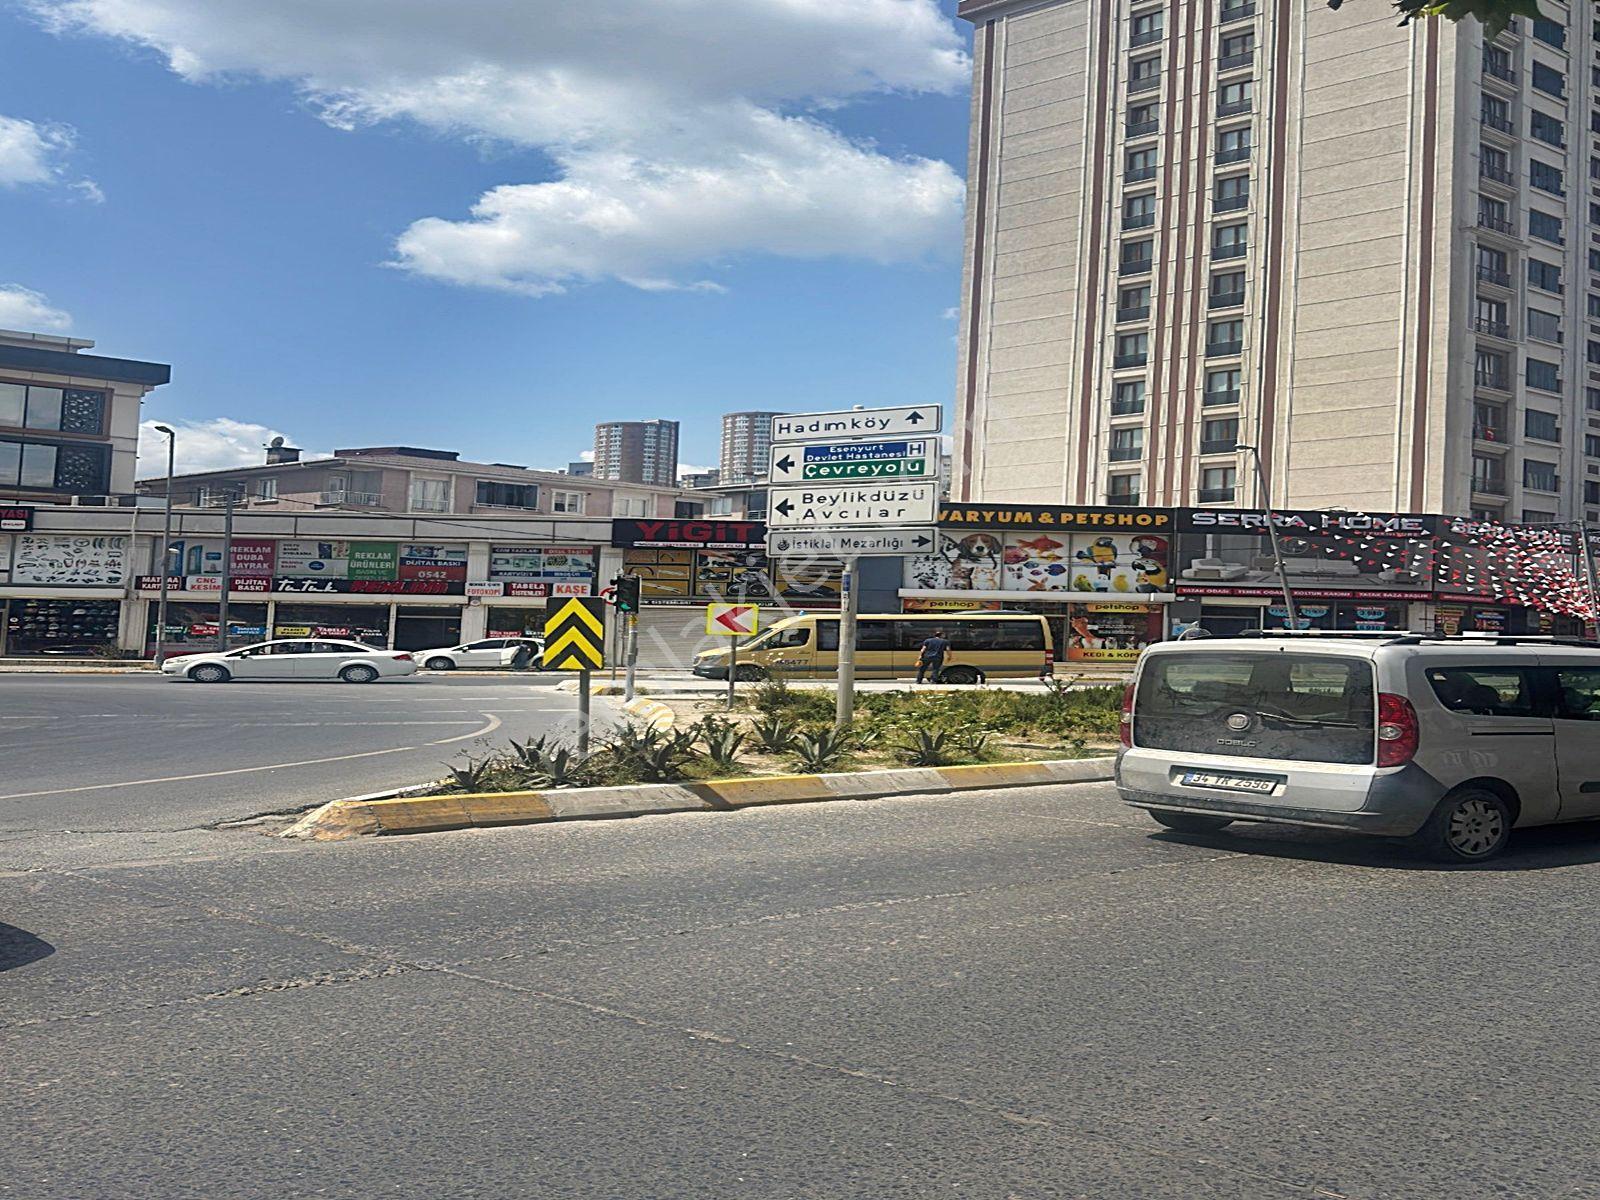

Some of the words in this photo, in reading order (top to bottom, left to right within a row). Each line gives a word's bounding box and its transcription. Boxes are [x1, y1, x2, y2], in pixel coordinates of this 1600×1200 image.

[778, 417, 891, 434] Hadımköy
[829, 444, 884, 453] Esenyurt
[806, 454, 843, 462] Devlet
[846, 451, 906, 460] Hastanesi
[805, 460, 920, 477] Çevreyolu
[802, 489, 925, 506] Beylikdüzü
[802, 507, 907, 520] Avcılar
[1038, 511, 1055, 524] &
[1060, 512, 1169, 526] PETSHOP
[1192, 512, 1309, 528] SERRA
[1321, 514, 1424, 531] HOME
[230, 546, 272, 554] REKLAM
[840, 537, 904, 552] Mezarlığı
[354, 552, 392, 560] REKLAM
[235, 578, 268, 586] DİJİTAL
[556, 584, 588, 596] KAŞE
[929, 600, 975, 608] petshop
[1095, 603, 1140, 612] petshop
[1193, 773, 1208, 783] 34
